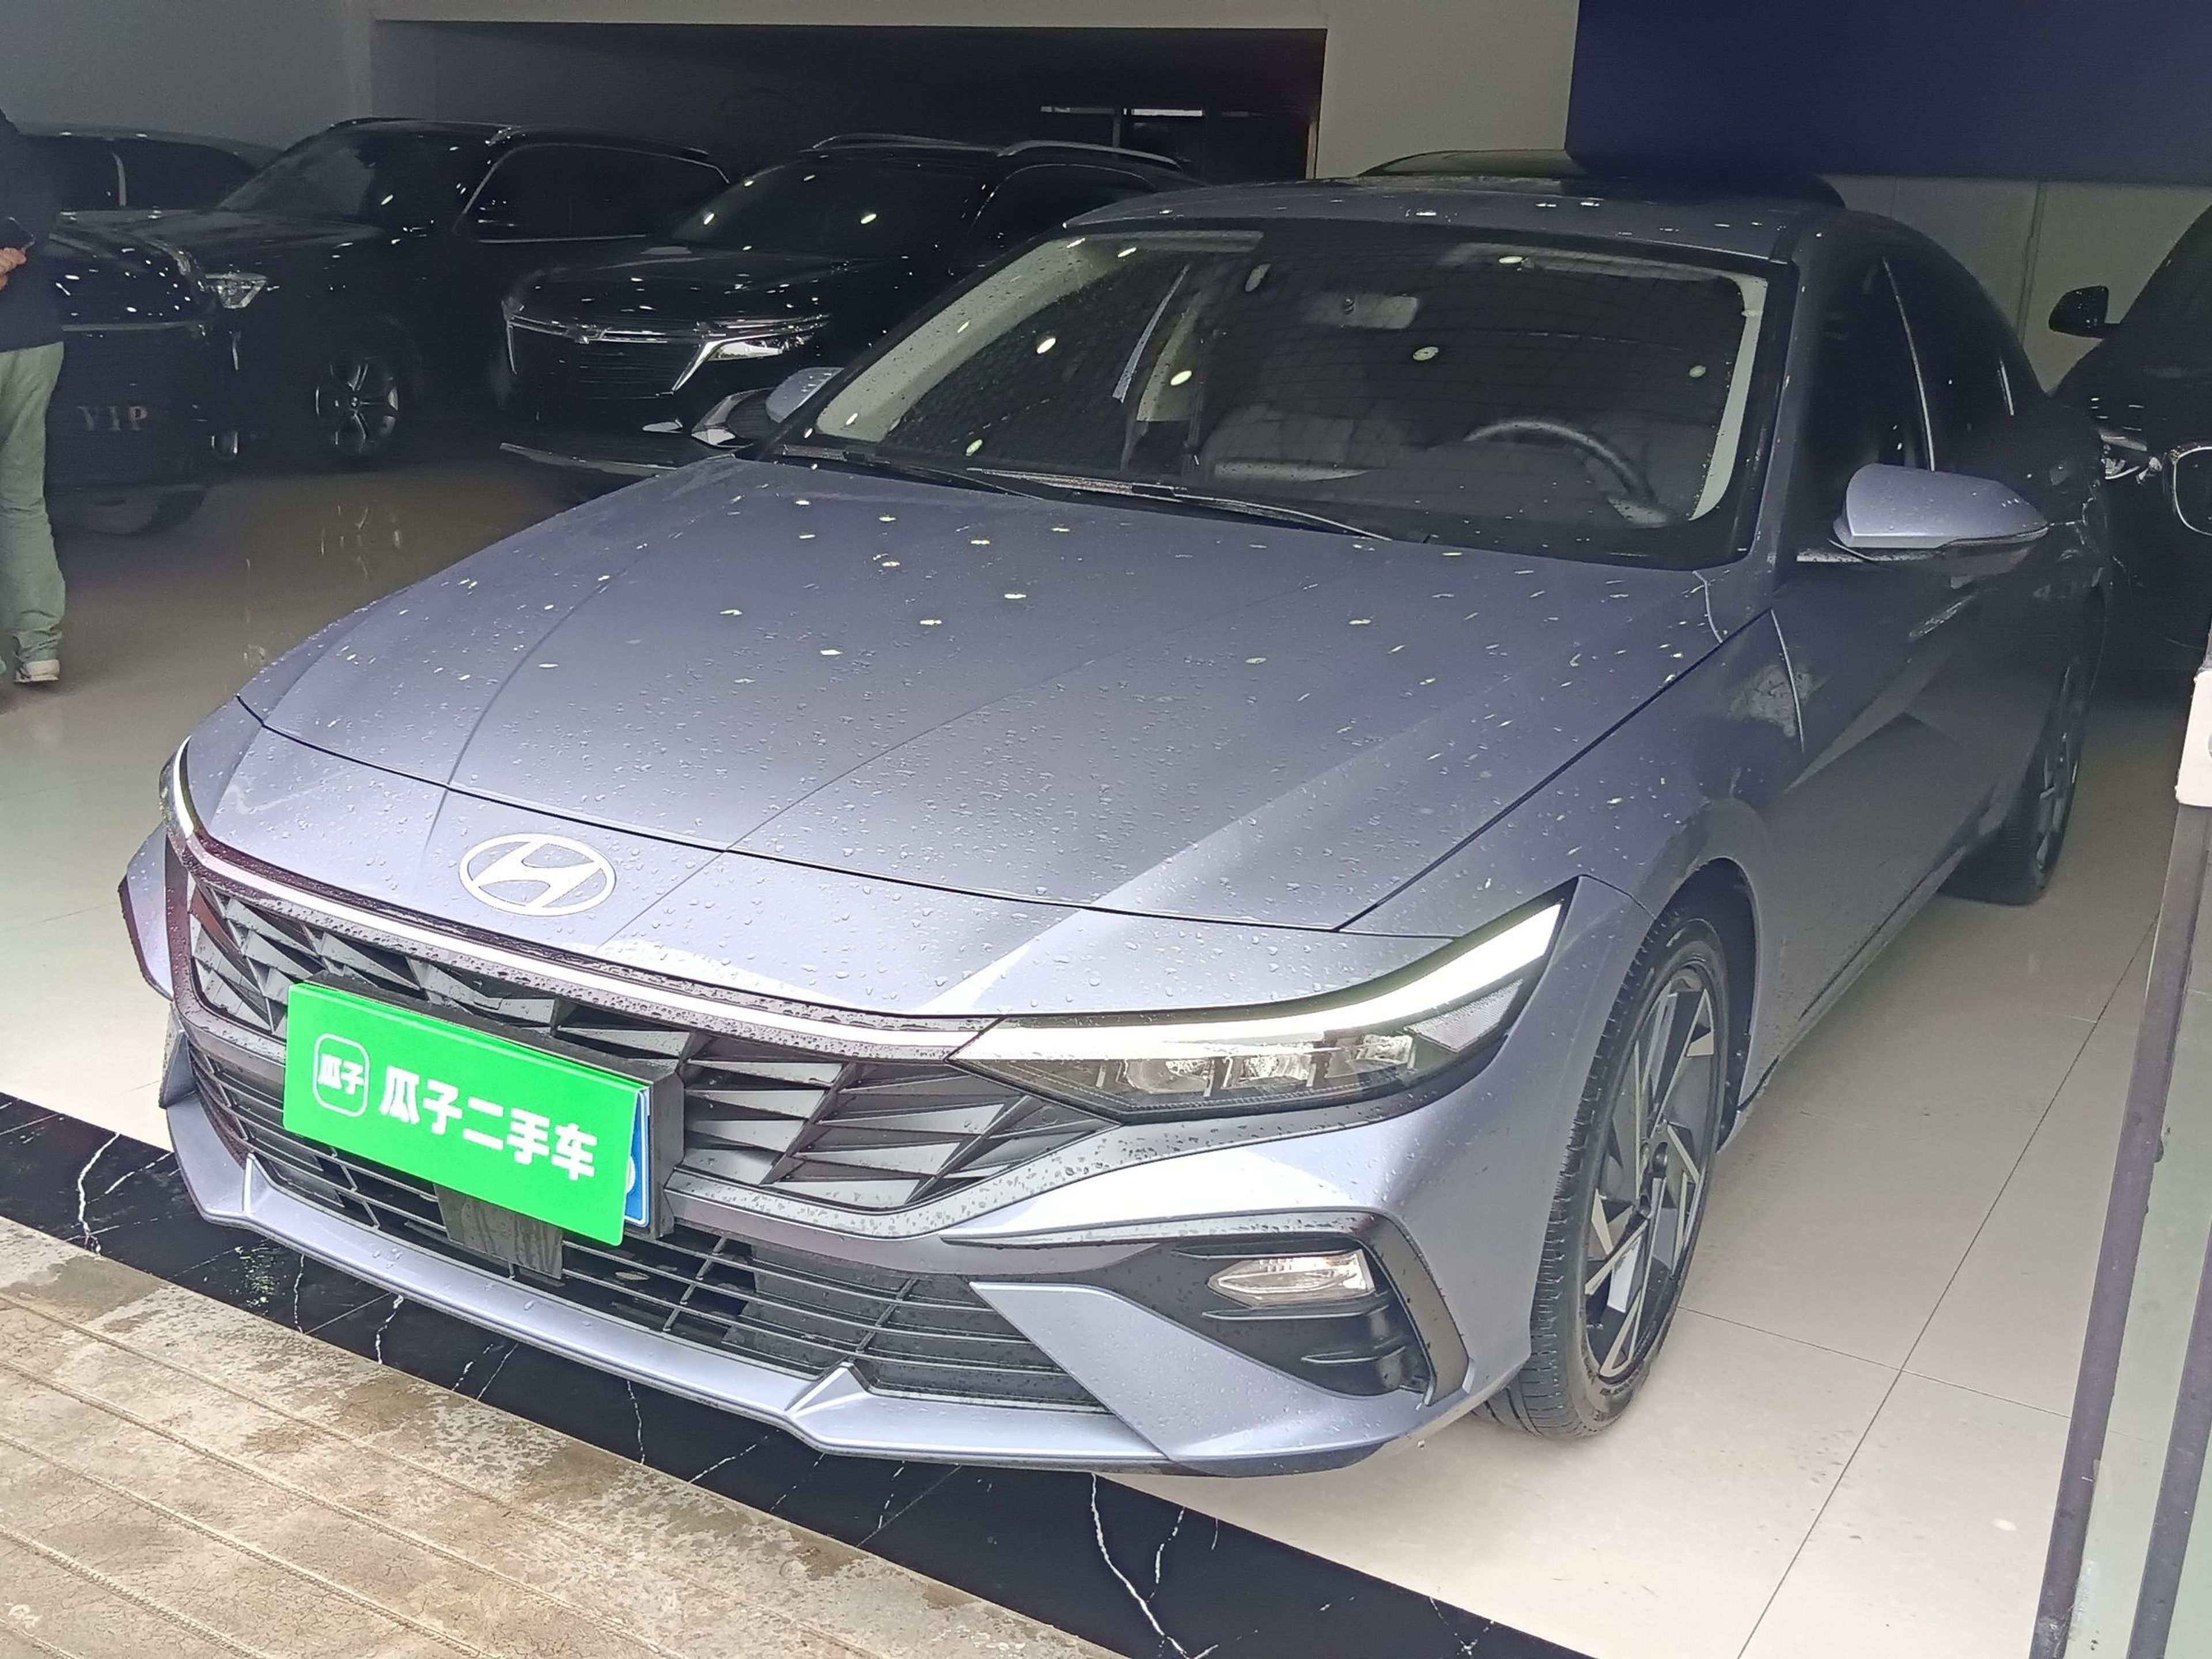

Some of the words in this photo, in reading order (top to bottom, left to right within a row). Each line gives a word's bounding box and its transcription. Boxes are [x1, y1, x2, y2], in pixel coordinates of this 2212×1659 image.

[77, 406, 147, 431] VIP
[318, 1054, 365, 1094] 瓜子
[379, 1066, 597, 1181] 瓜子二手车
